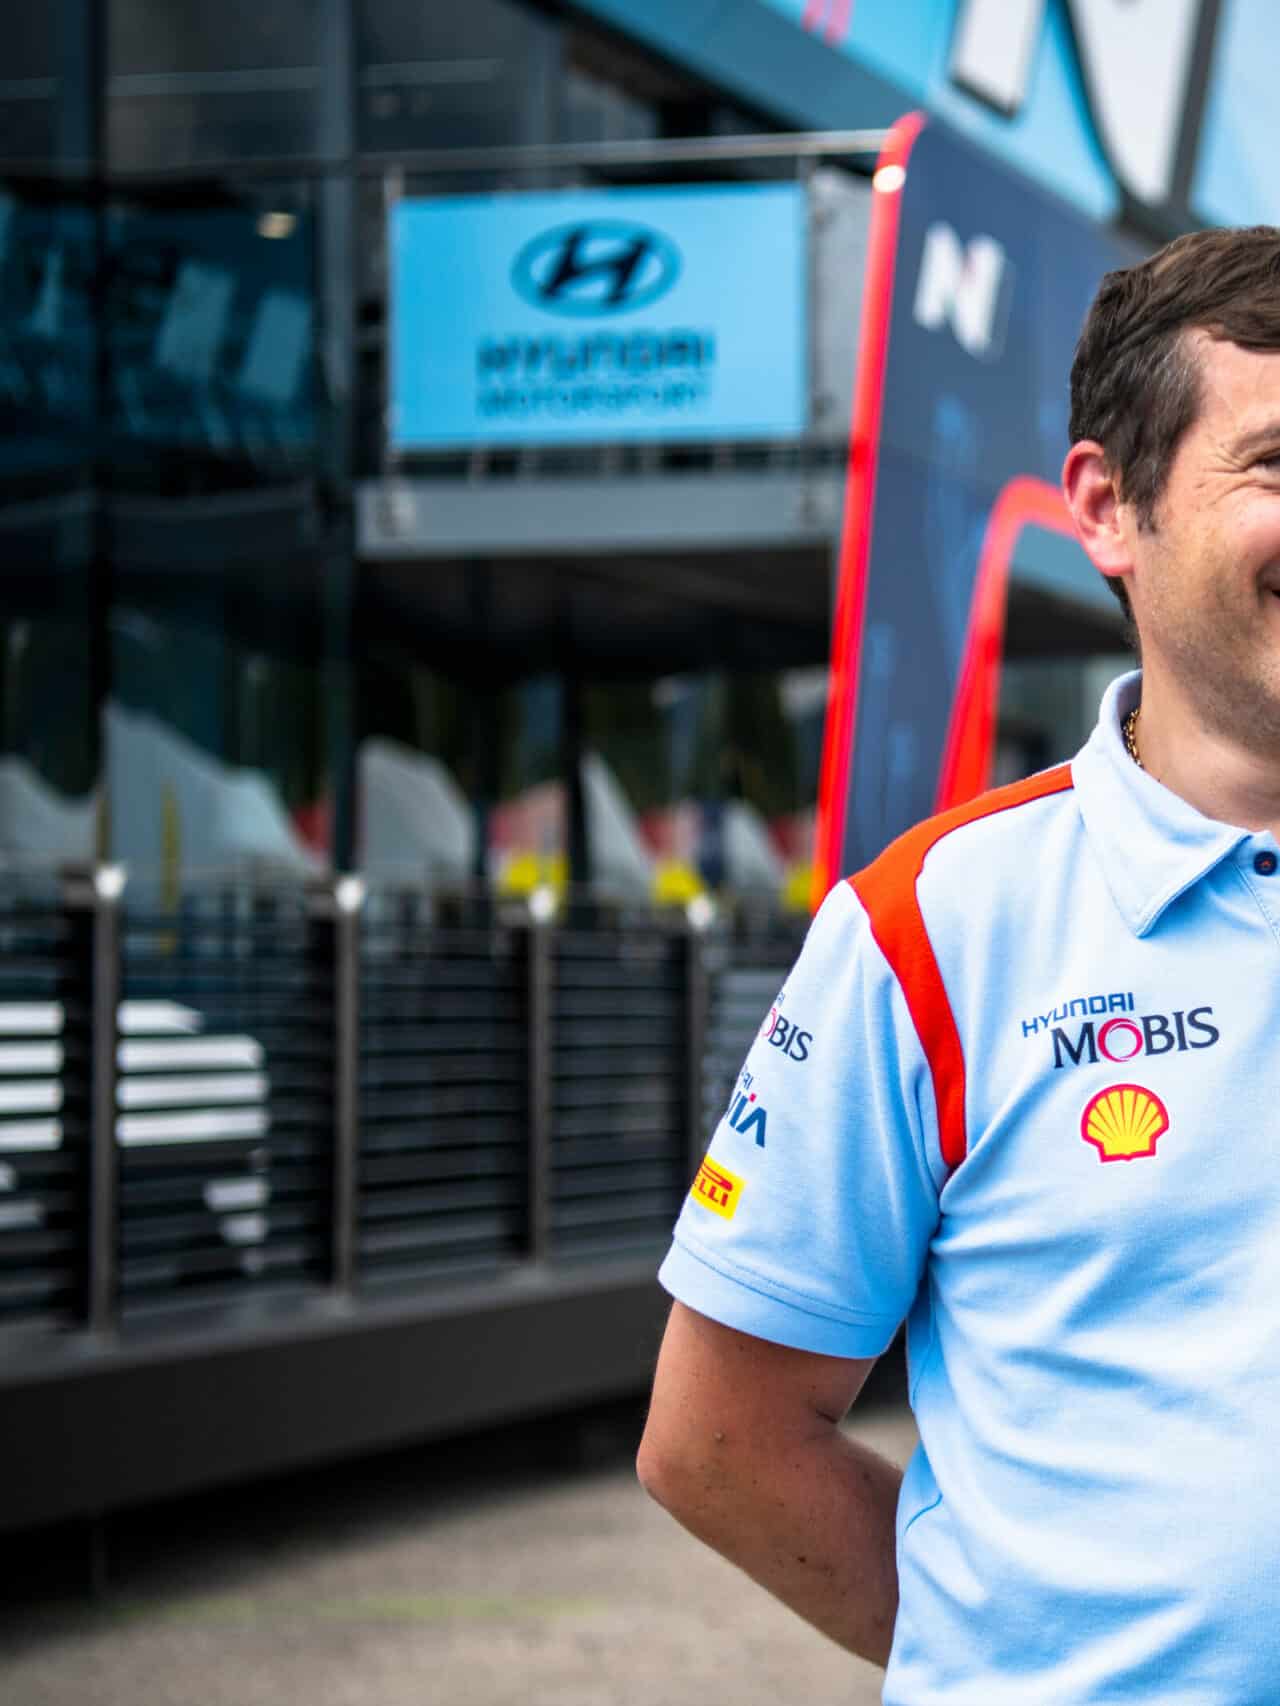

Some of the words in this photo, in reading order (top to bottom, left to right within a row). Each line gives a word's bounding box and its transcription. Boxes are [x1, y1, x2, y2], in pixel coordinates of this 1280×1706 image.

[476, 329, 717, 378] HYUNDAI
[1022, 992, 1135, 1038] HYUNDAI
[1051, 1006, 1220, 1069] MOBIS
